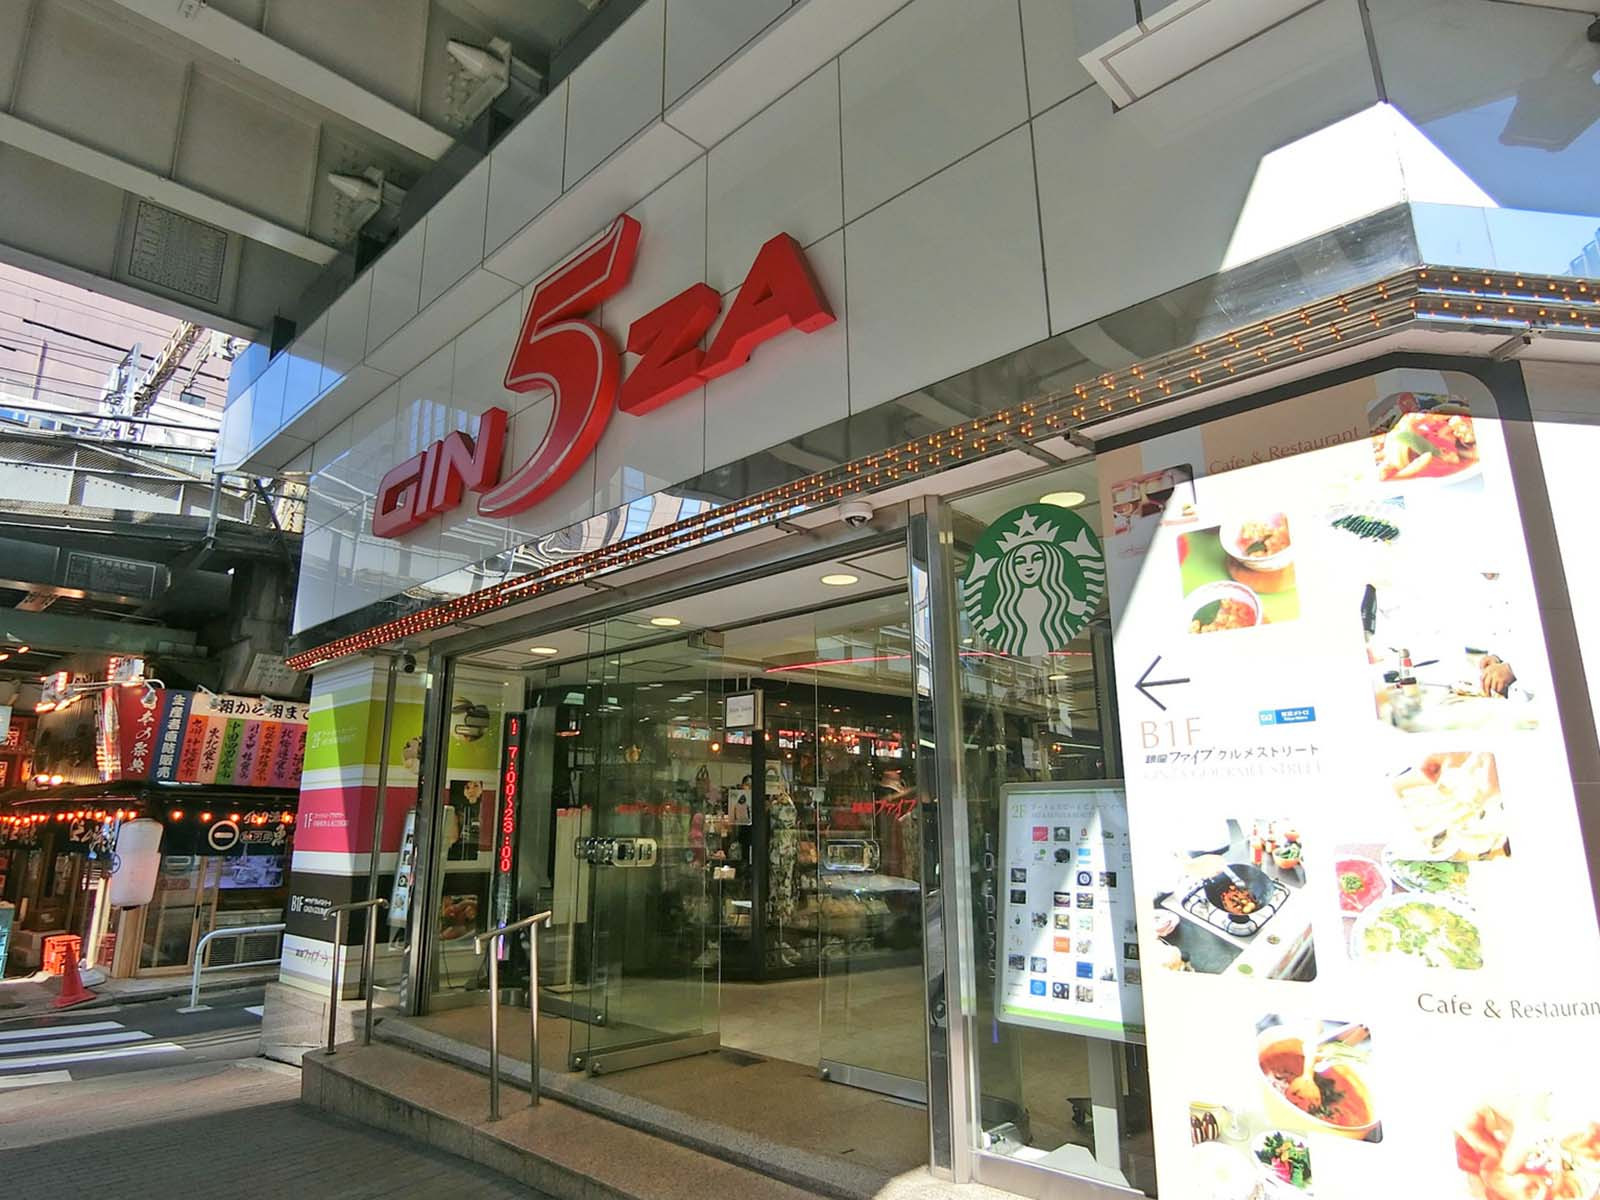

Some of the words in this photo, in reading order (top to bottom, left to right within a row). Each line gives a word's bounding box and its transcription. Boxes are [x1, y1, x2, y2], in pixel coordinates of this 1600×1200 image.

[1209, 456, 1246, 474] Cafe
[1250, 451, 1264, 465] &
[1269, 426, 1360, 460] Restaurant
[1140, 717, 1200, 749] B1F
[1417, 993, 1473, 1016] Cafe
[1483, 999, 1502, 1019] &
